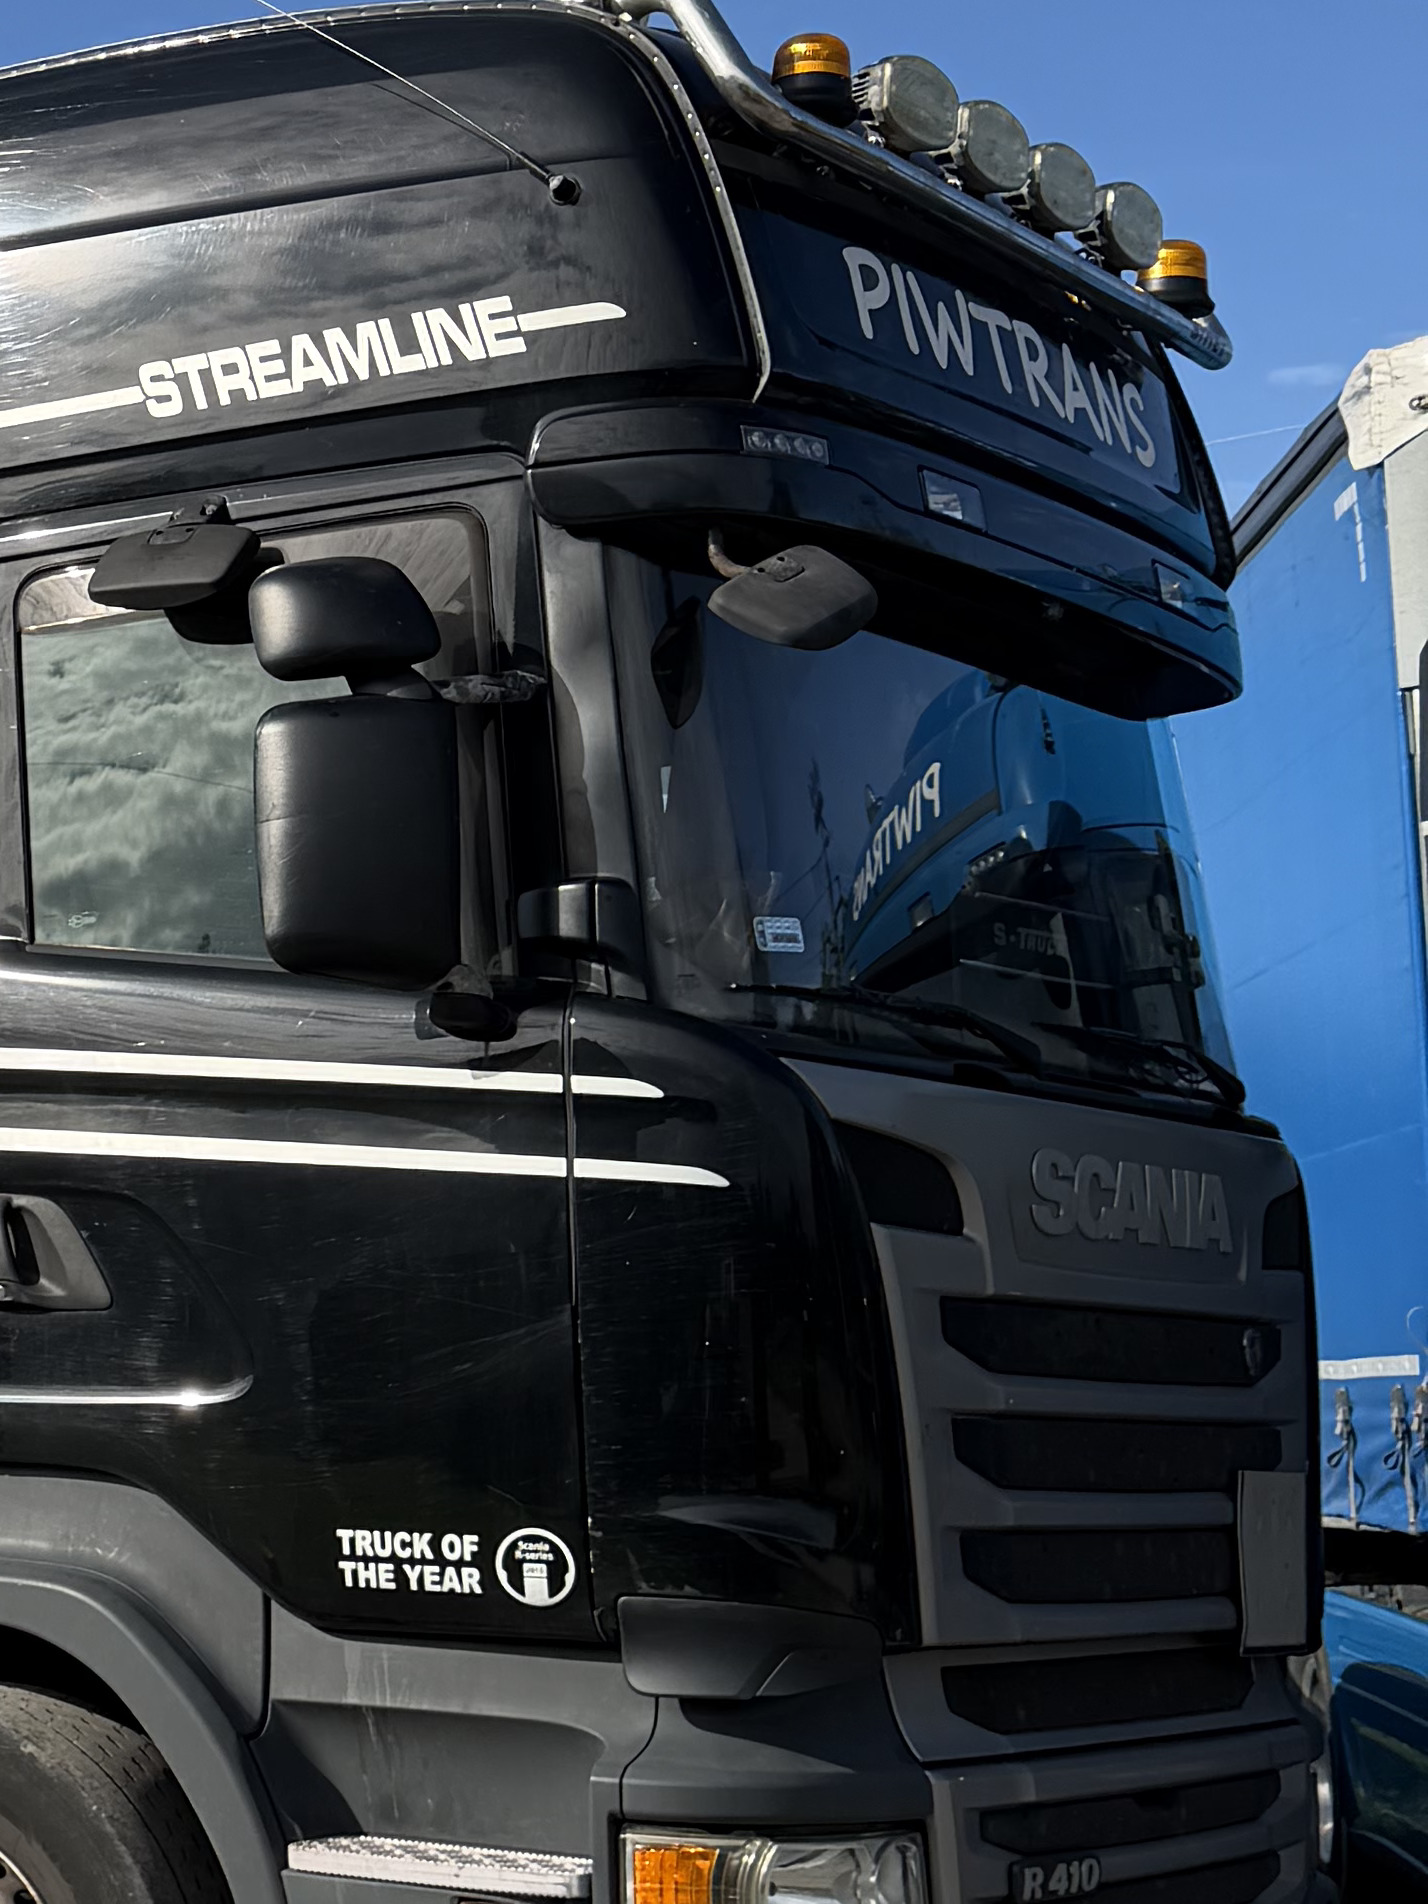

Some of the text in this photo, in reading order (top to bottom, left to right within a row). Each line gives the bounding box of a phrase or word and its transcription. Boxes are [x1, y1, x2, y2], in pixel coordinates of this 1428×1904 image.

[138, 295, 527, 419] STREAMLINE
[843, 246, 1154, 467] PIWTRANS
[1031, 1147, 1233, 1254] SCANIA
[336, 1528, 479, 1562] TRUCK OF
[338, 1560, 483, 1594] THE YEAR
[1023, 1857, 1100, 1901] R 410
